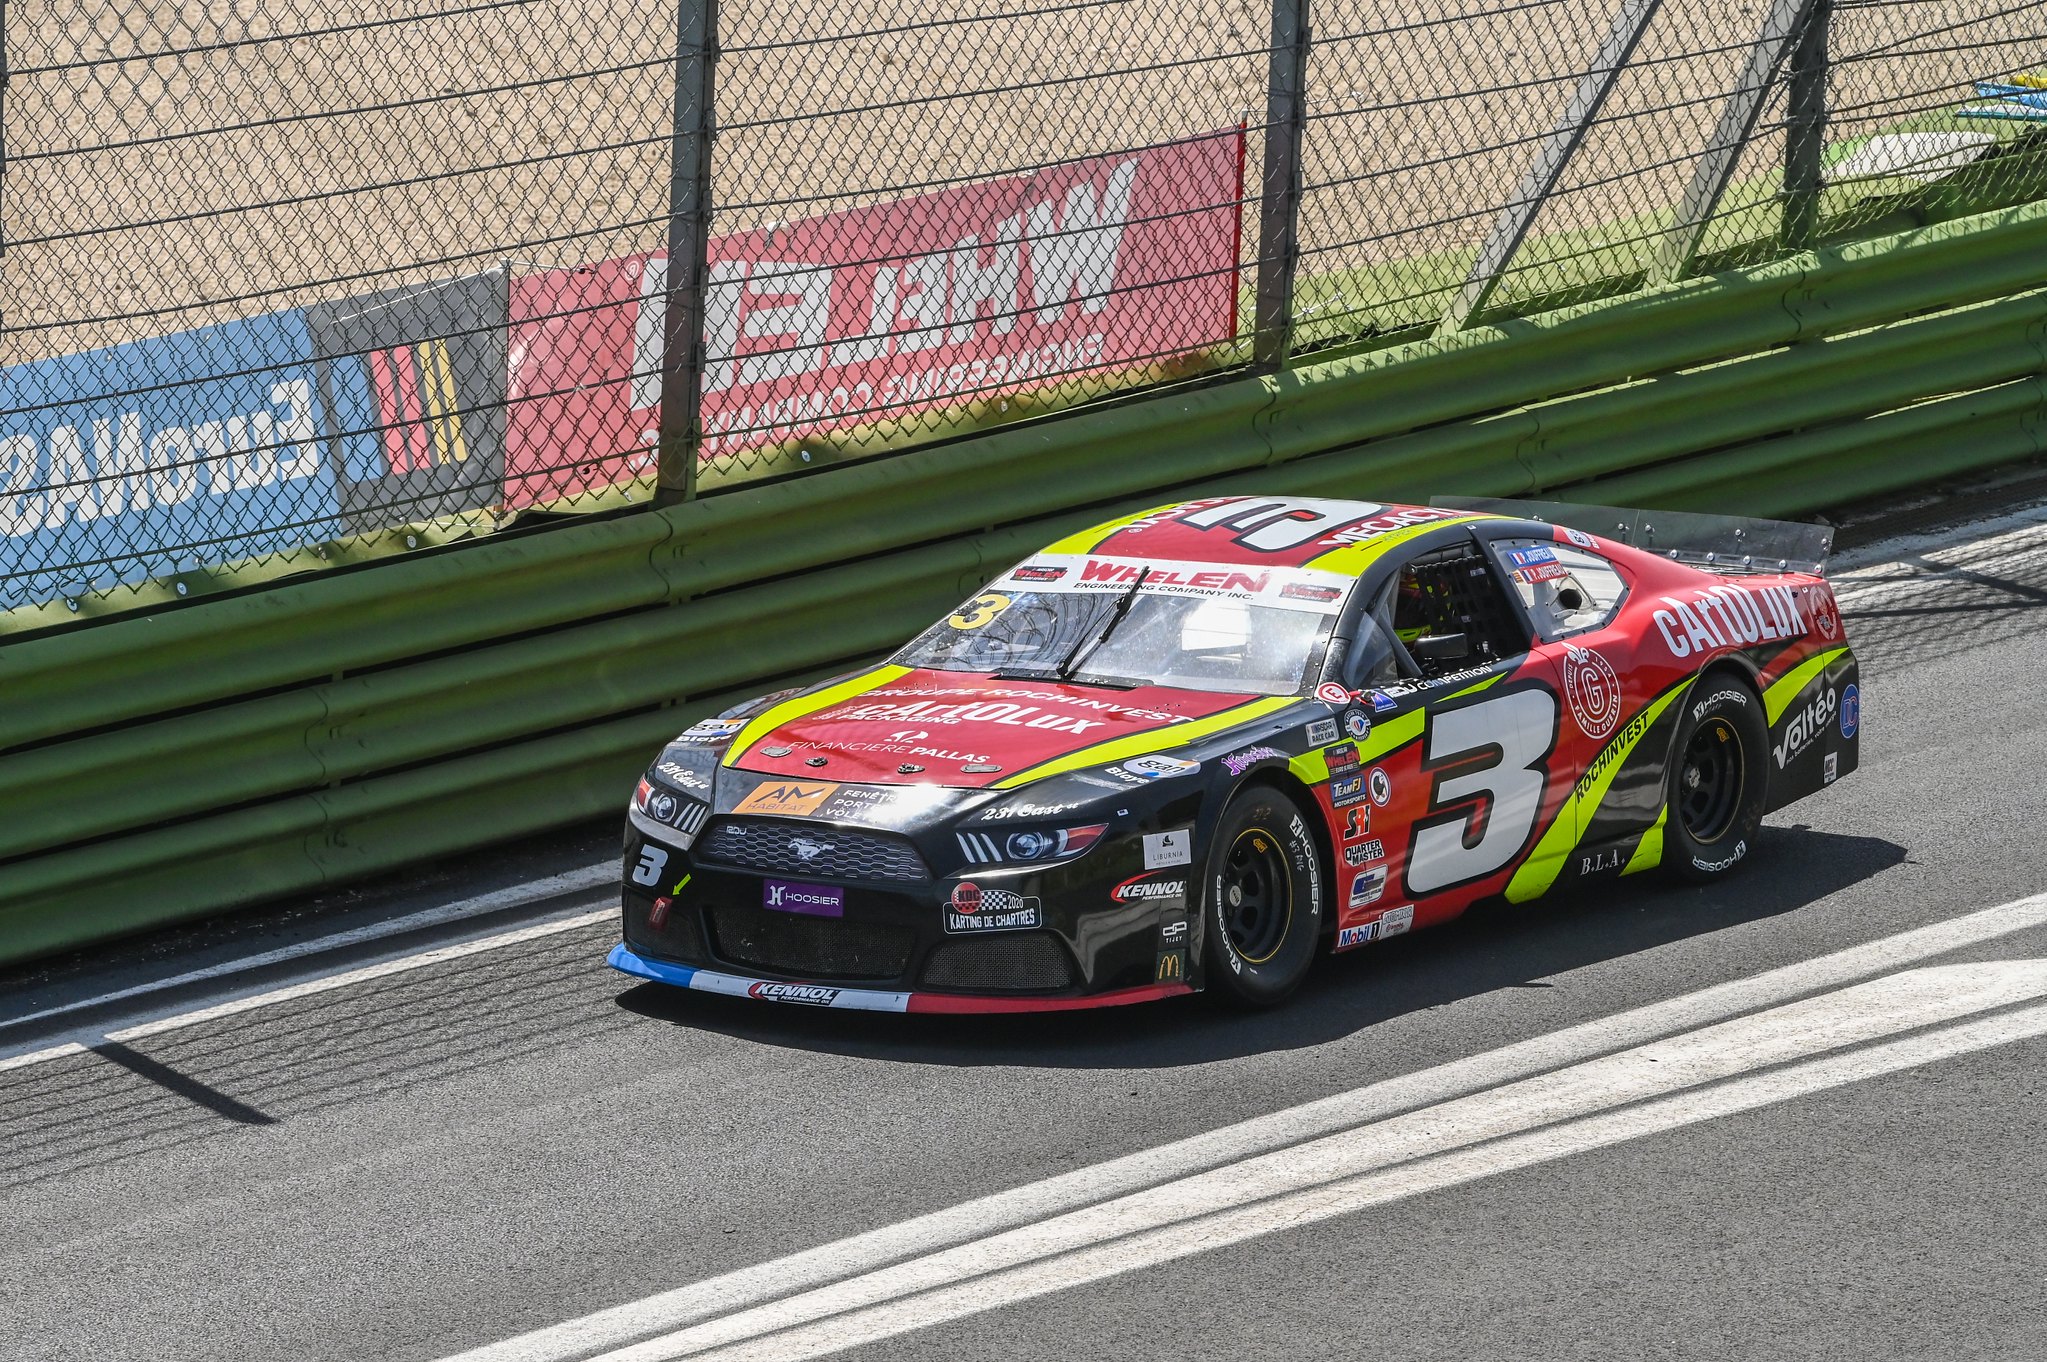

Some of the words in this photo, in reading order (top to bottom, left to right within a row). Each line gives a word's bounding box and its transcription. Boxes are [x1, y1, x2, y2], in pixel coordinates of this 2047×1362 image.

[1180, 496, 1384, 551] 3
[1080, 560, 1271, 592] WHELEN
[1074, 582, 1156, 592] ENGINEERNG
[1158, 586, 1225, 597] COMPANY
[1227, 592, 1254, 601] INC.
[948, 594, 1010, 629] 3
[1417, 665, 1493, 690] COMPETITION
[1326, 688, 1342, 700] E
[1581, 667, 1605, 715] G
[1703, 690, 1748, 707] HOOSIER
[858, 688, 986, 697] GROUPE
[982, 688, 1195, 723] ROCHINVEST
[1574, 705, 1600, 734] FAMILLE
[1601, 694, 1618, 732] GUERIN
[837, 714, 961, 725] PACKAGING
[1773, 688, 1836, 769] Voltéo
[1311, 732, 1325, 742] RACE
[1324, 729, 1335, 738] CAR
[908, 747, 990, 763] PALLAS
[1325, 749, 1360, 768] WHELEN
[1575, 712, 1650, 804] ROCHINVEST
[754, 785, 826, 804] AM
[1405, 686, 1558, 896] 3
[745, 802, 807, 812] HABITAT
[1017, 803, 1064, 817] East
[1334, 794, 1367, 808] MOTORSPORTS
[1152, 850, 1184, 862] LIBURNIA
[1345, 839, 1381, 861] QUARTER
[1352, 848, 1383, 866] MASTER
[632, 843, 669, 887] 3
[1580, 849, 1626, 876] B.L.A.
[1692, 854, 1737, 872] HOOSIER
[1299, 830, 1319, 915] HOOSIER
[785, 892, 840, 906] HOOSIER
[1117, 881, 1184, 898] KENNOL
[1142, 893, 1174, 901] PERFORMANCE
[1007, 895, 1024, 909] 2020
[949, 913, 982, 930] KARTING
[984, 915, 994, 928] DE
[995, 908, 1035, 927] CHARTRES
[1216, 874, 1236, 960] HOOSIER
[1340, 925, 1370, 946] Mobil
[1371, 922, 1380, 938] 1
[755, 983, 836, 1000] KENNOL
[780, 995, 820, 1003] PERFORMANCE
